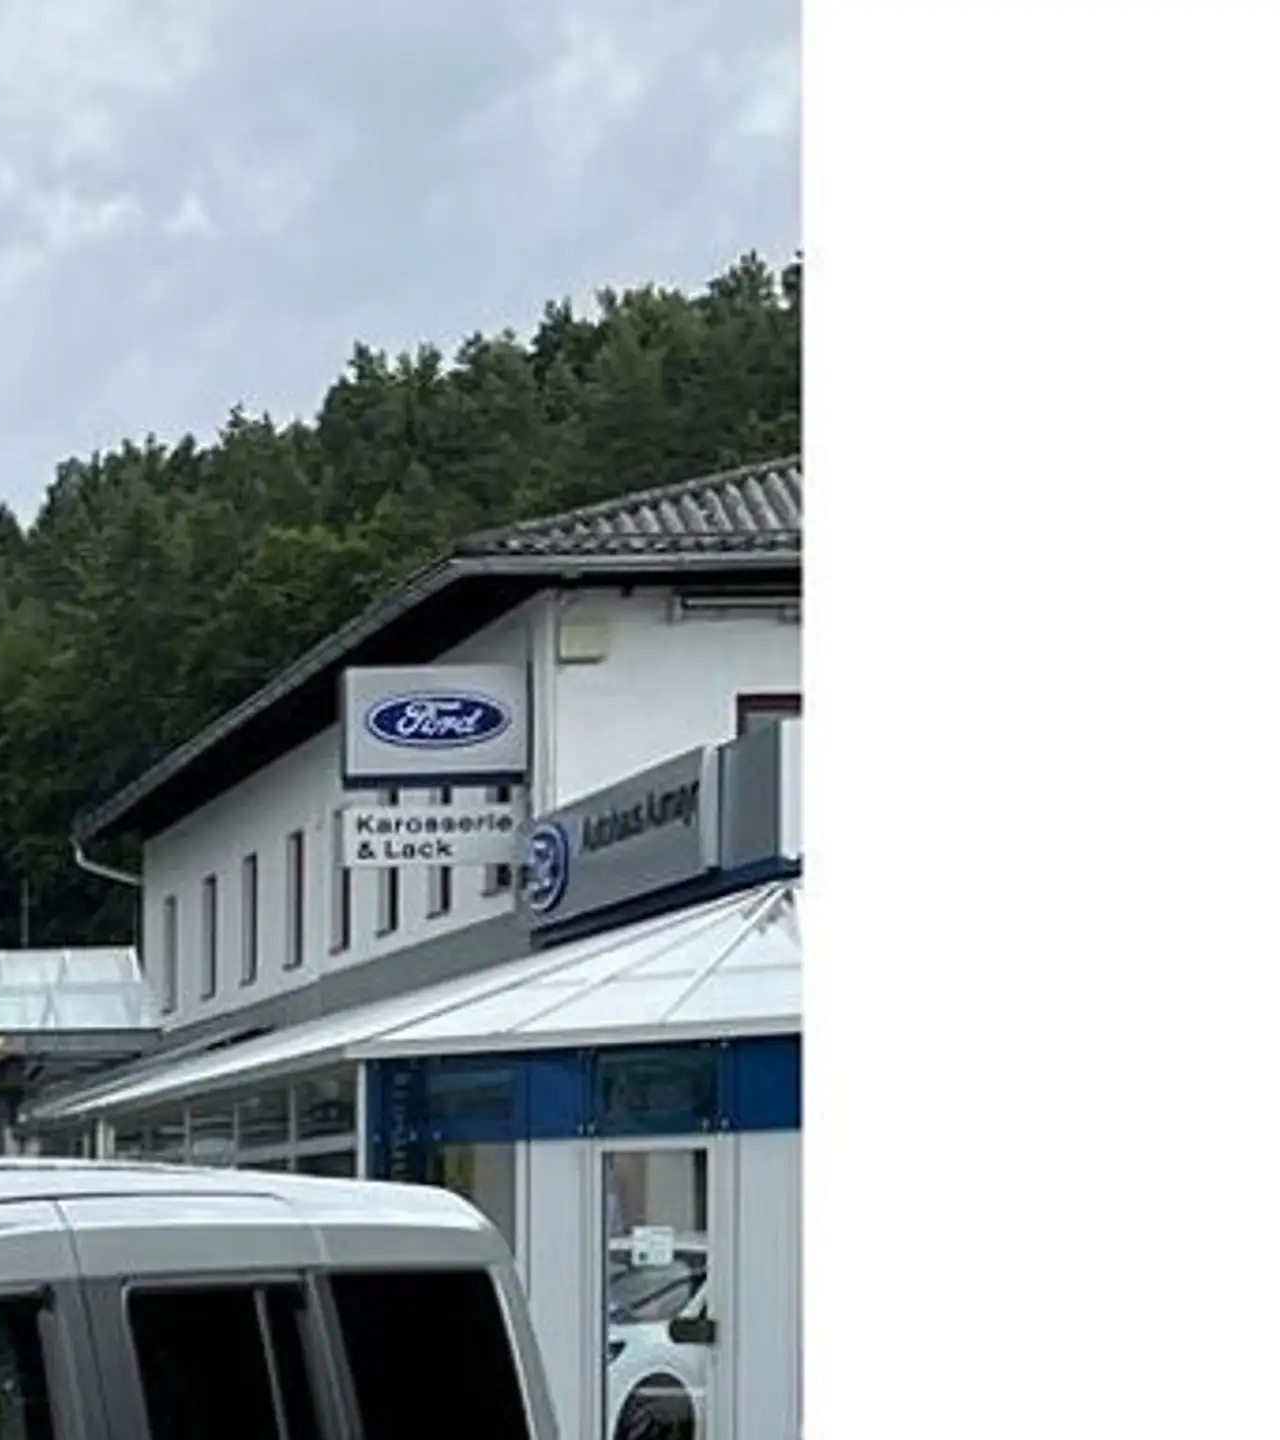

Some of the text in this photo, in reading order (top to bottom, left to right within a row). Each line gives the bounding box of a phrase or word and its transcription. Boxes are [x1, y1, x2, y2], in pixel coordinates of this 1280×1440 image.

[396, 700, 483, 737] Ford
[357, 813, 513, 835] Karosserie
[357, 838, 454, 860] & Lack
